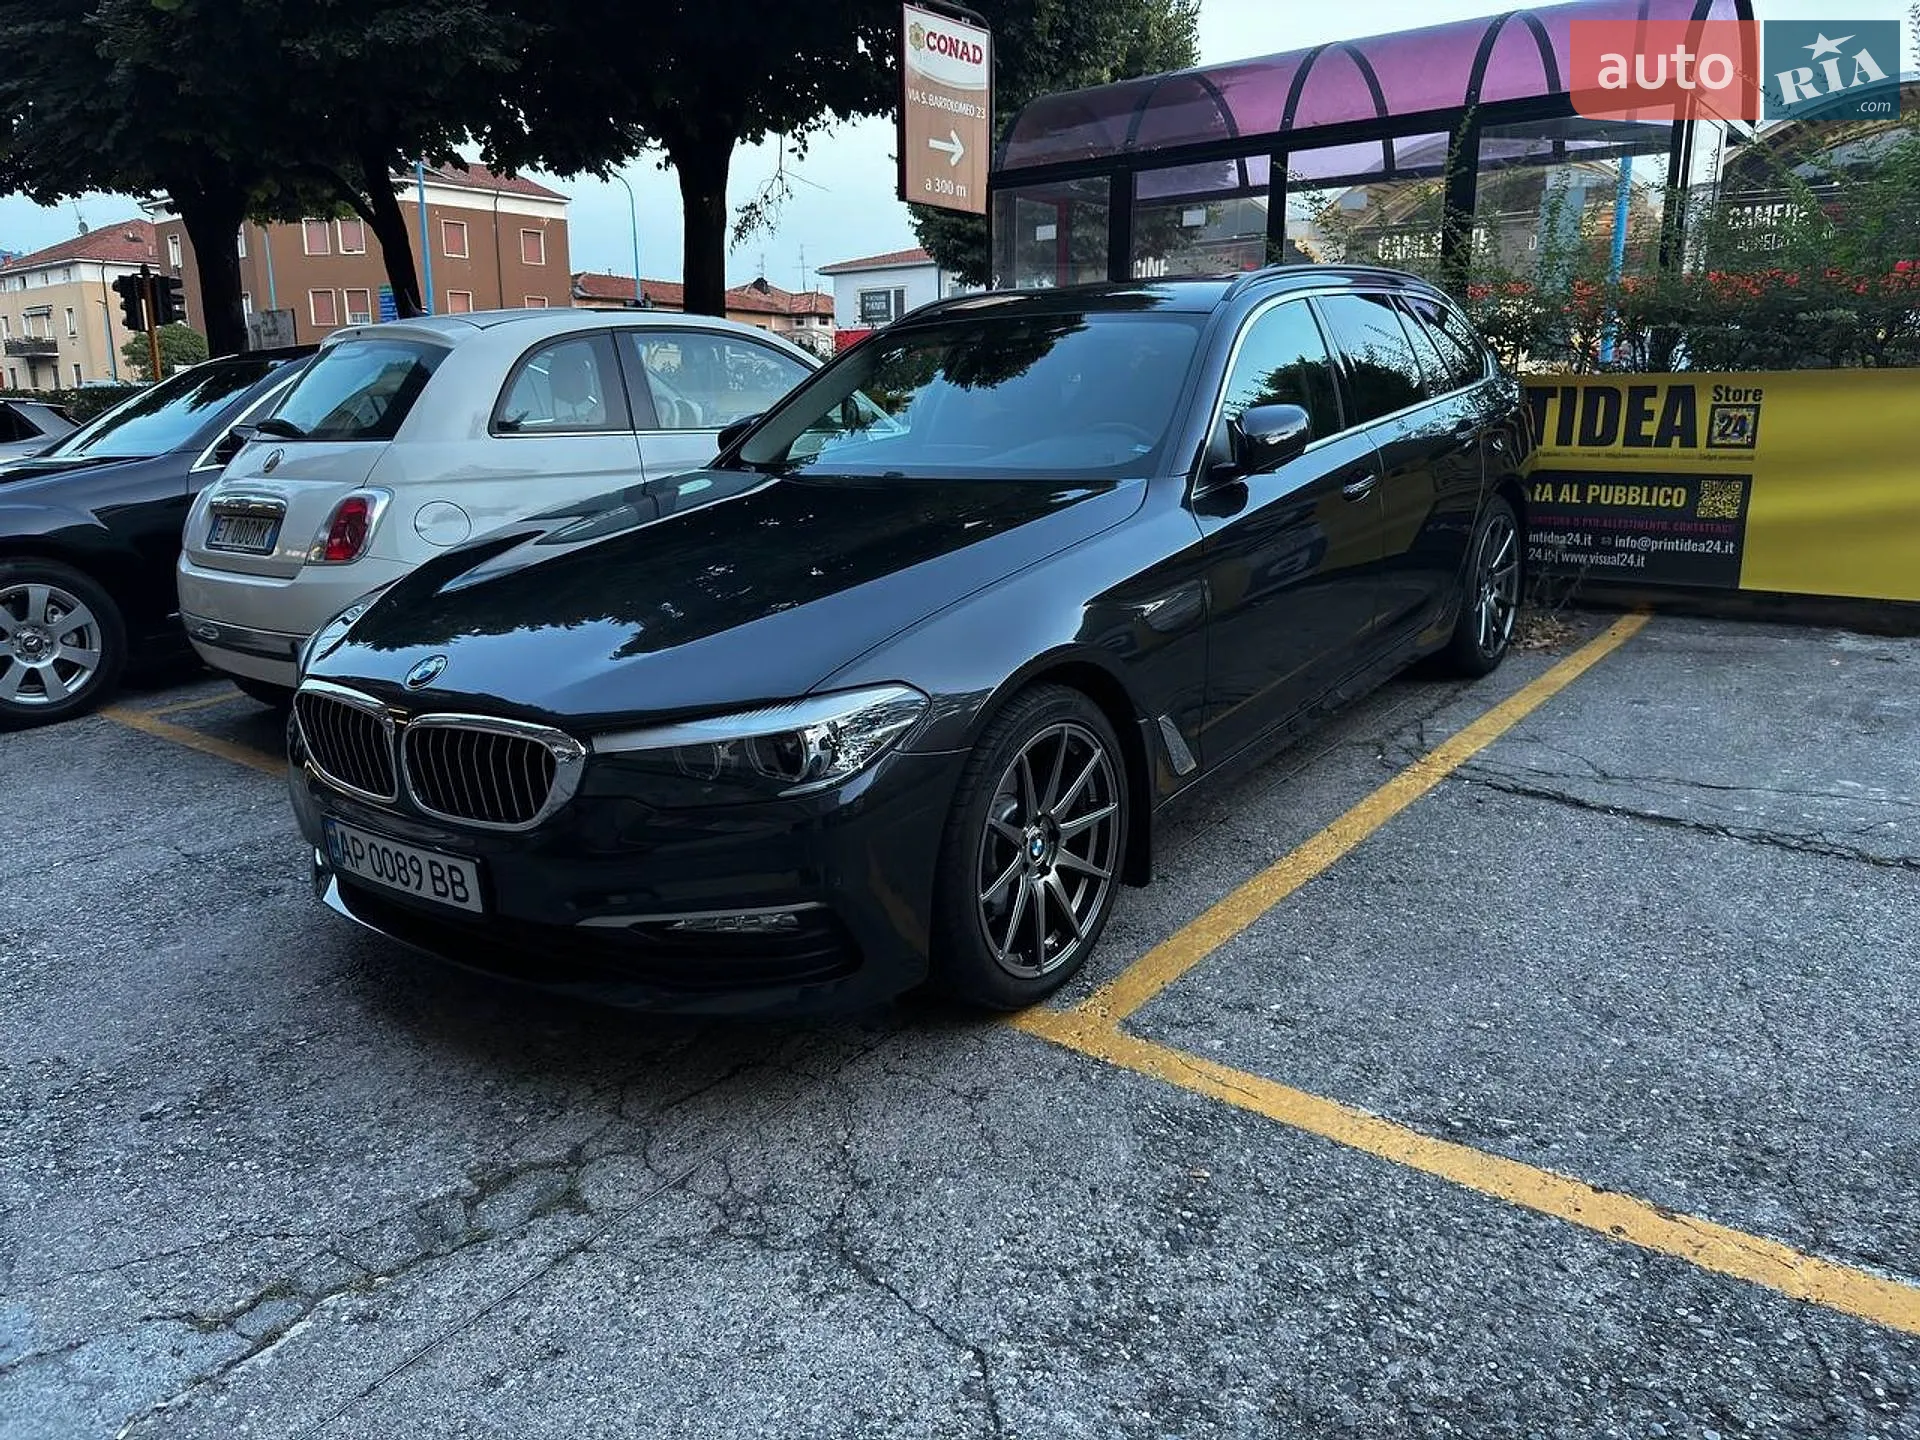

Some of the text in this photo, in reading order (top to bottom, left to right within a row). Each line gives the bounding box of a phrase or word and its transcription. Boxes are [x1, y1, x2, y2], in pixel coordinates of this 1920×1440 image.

[926, 31, 983, 65] CONAD
[925, 177, 967, 197] a 300 m
[1712, 384, 1763, 403] Store
[1528, 385, 1697, 448] TIDEA
[1558, 484, 1581, 504] AL
[1586, 484, 1687, 508] PUBBLICO
[1614, 535, 1735, 555] info@printidea24.it
[1561, 551, 1645, 568] www.visual24.it
[340, 831, 365, 871] AP
[368, 842, 423, 891] 0089
[428, 859, 469, 903] BB
